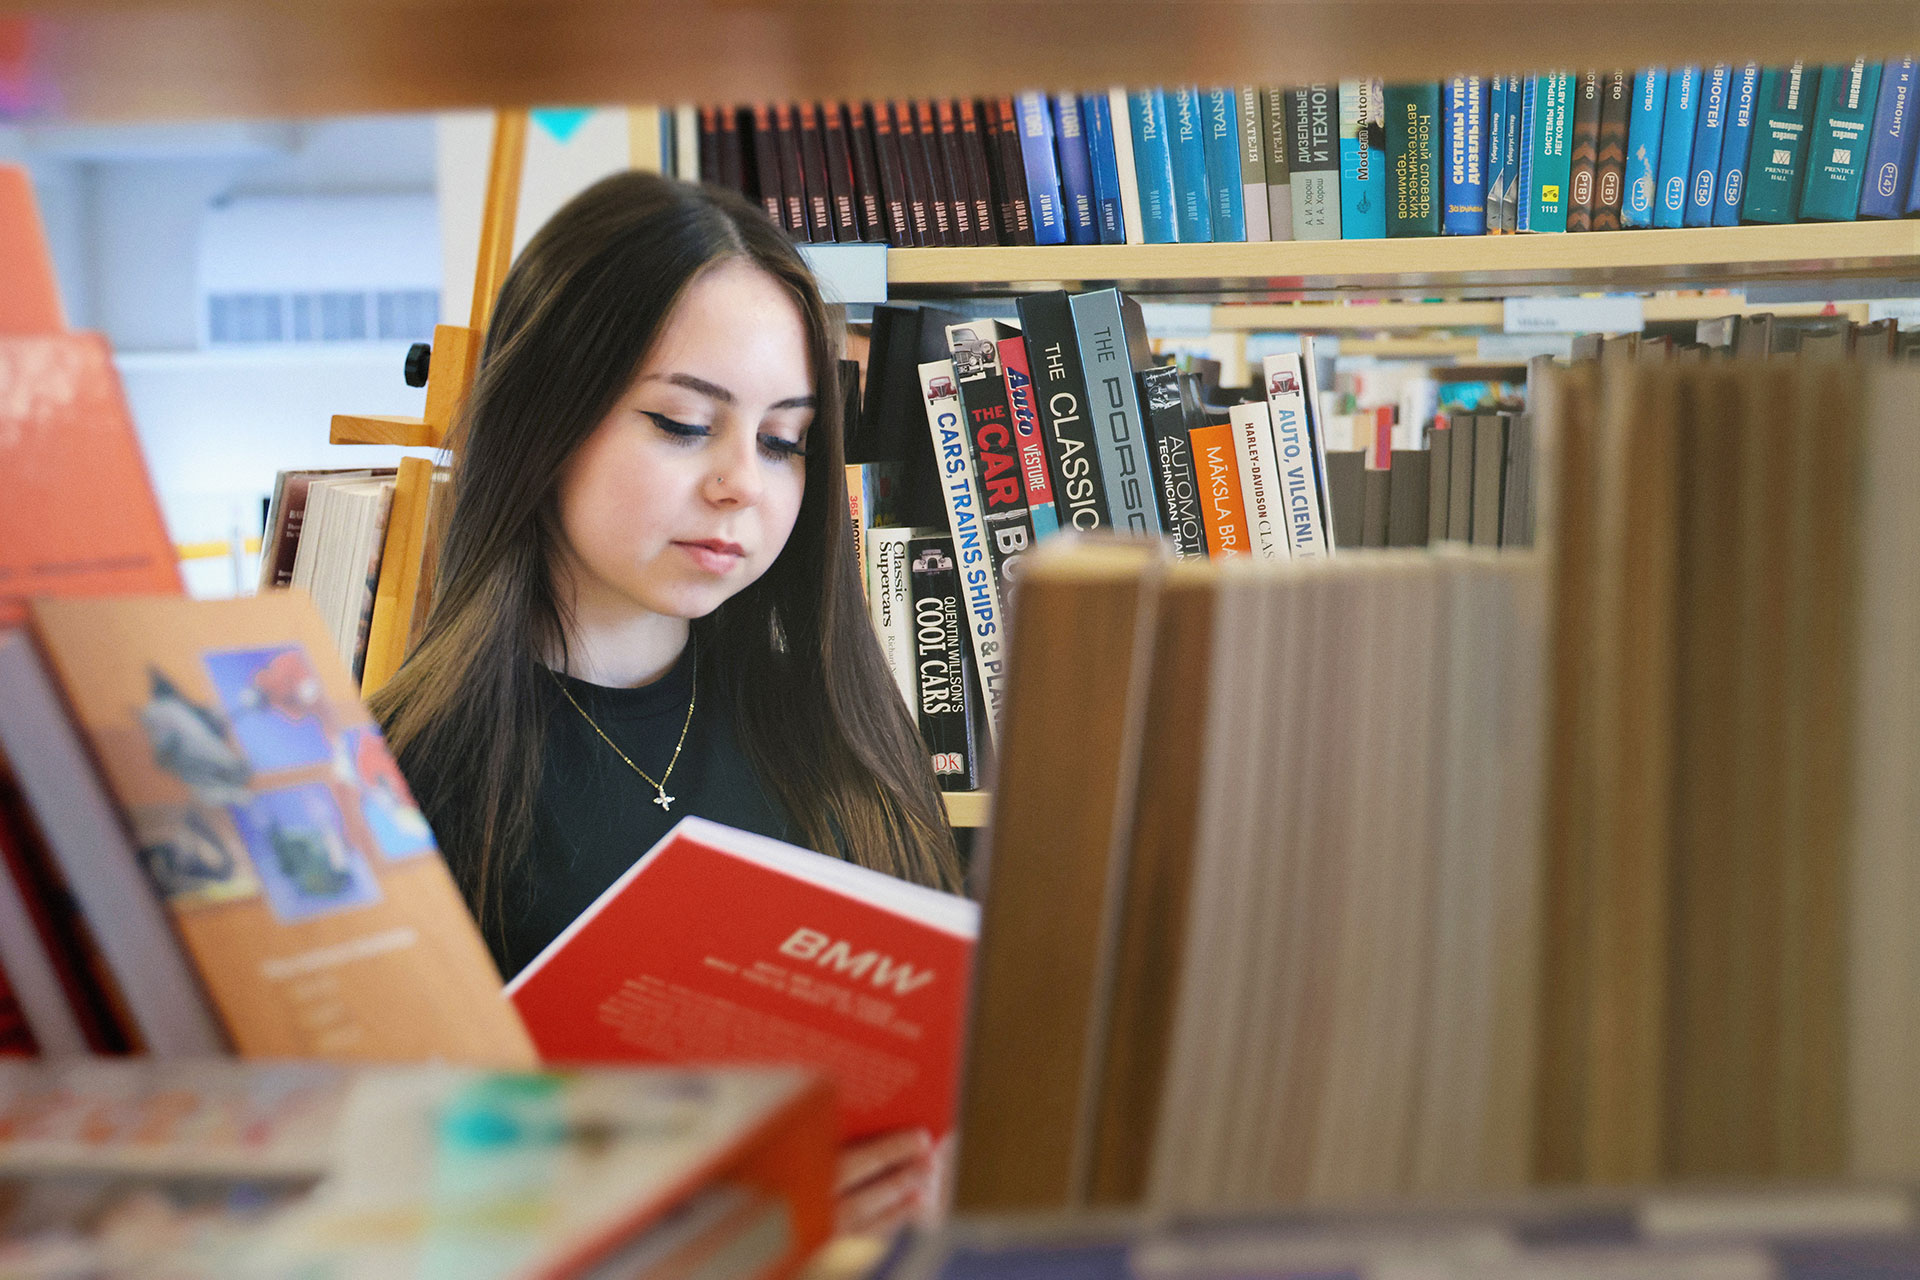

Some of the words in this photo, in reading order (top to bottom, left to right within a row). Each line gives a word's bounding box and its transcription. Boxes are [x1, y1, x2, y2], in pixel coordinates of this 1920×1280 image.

[1453, 75, 1465, 109] УПР
[1296, 90, 1311, 163] ДИЗЕЛЬНЫЕ
[1555, 104, 1565, 156] ЛЕГКОВЫХ
[1889, 86, 1907, 138] ремонту
[1419, 115, 1431, 160] Новый
[1453, 112, 1465, 185] СИСТЕМЫ
[1544, 108, 1555, 156] СИСТЕМЫ
[1313, 151, 1329, 162] И
[1357, 129, 1369, 181] Modern
[1407, 104, 1419, 219] автотехнических
[1764, 166, 1795, 175] PRENTICE
[1824, 165, 1854, 175] PRENTICE
[1305, 178, 1314, 205] Хорош
[1316, 178, 1325, 205] Хорош
[1397, 153, 1408, 220] терминов
[1420, 163, 1431, 219] словарь
[1771, 173, 1787, 181] HALL
[1830, 173, 1847, 181] HALL
[789, 196, 802, 229] JUMAVA
[814, 196, 827, 228] JUMAVA
[838, 196, 852, 228] JUMAVA
[864, 195, 878, 226] JUMAVA
[891, 201, 905, 232] JUMAVA
[913, 201, 927, 232] JUMAVA
[935, 201, 949, 232] JUMAVA
[955, 201, 969, 232] JUMAVA
[976, 200, 990, 231] JUMAVA
[1015, 200, 1028, 231] JUMAVA
[1040, 194, 1054, 227] JUMAVA
[1076, 194, 1091, 227] JUMAVA
[1104, 203, 1115, 231] JUMAVA
[1150, 189, 1162, 220] JUMAVA
[1187, 191, 1198, 221] JUMAVA
[1219, 188, 1231, 218] JUMAVA
[1541, 205, 1558, 214] 1113
[1045, 342, 1066, 381] THE
[1094, 326, 1116, 363] THE
[971, 405, 1006, 422] THE
[1005, 366, 1035, 437] Auto
[1023, 444, 1046, 492] VĒSTURE
[937, 412, 966, 479] CARS,
[1278, 409, 1301, 463] AUTO,
[977, 423, 1020, 507] CAR
[1049, 392, 1100, 533] CLASSIC
[1158, 436, 1179, 522] TECHNICIAN
[1244, 422, 1267, 518] HARLEY-DAVIDSON
[1206, 446, 1232, 521] MĀKSLA
[849, 495, 859, 516] 365
[950, 478, 983, 569] TRAINS,
[1287, 466, 1313, 548] VILCIENI,
[877, 541, 892, 627] Supercars
[893, 540, 907, 602] Classic
[943, 596, 959, 647] QUENTIN
[967, 569, 997, 637] SHIPS
[915, 597, 946, 656] COOL
[980, 641, 999, 658] &
[920, 659, 951, 715] CARS
[949, 648, 964, 713] WILLSON'S
[935, 754, 961, 771] DK
[779, 926, 936, 995] BMW
